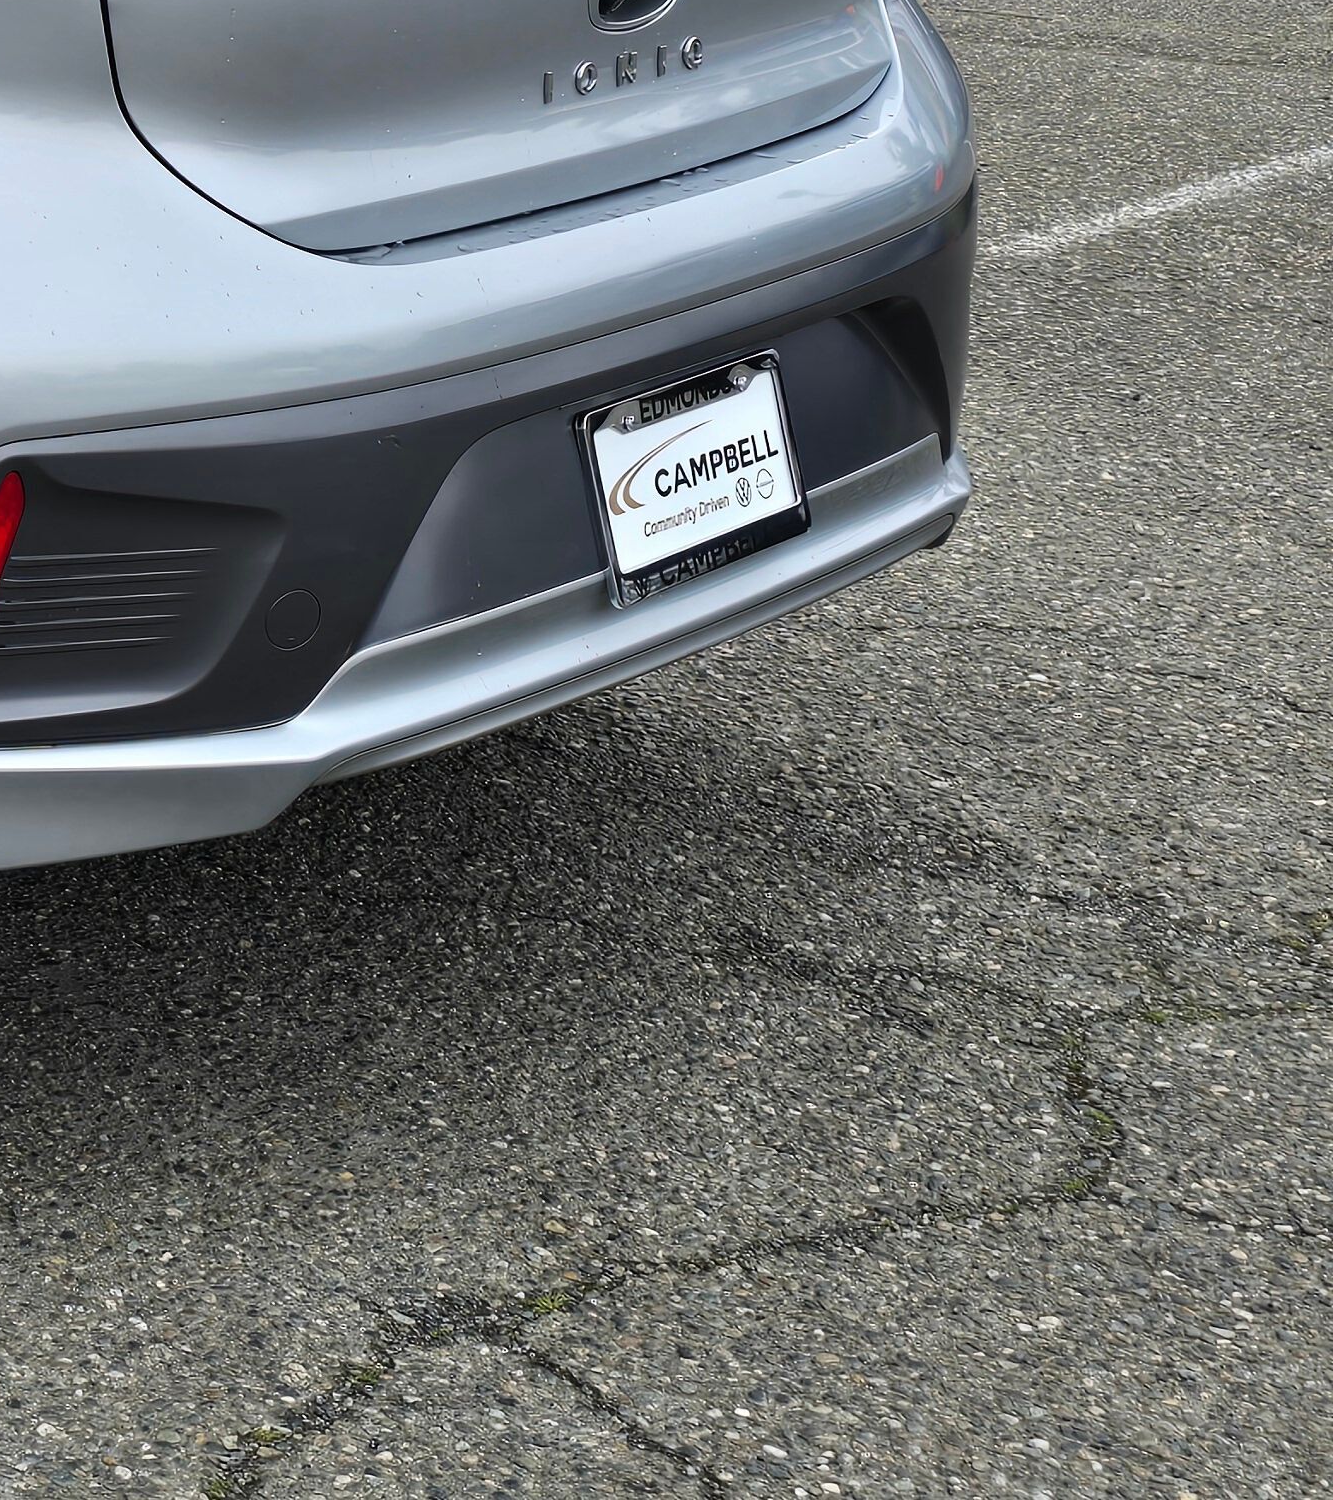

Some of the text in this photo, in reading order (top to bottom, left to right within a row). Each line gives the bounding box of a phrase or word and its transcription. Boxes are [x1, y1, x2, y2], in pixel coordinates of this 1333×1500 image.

[543, 35, 704, 105] IONIQ
[653, 429, 779, 498] CAMPBELL
[643, 505, 697, 538] Community
[699, 494, 730, 518] Driven
